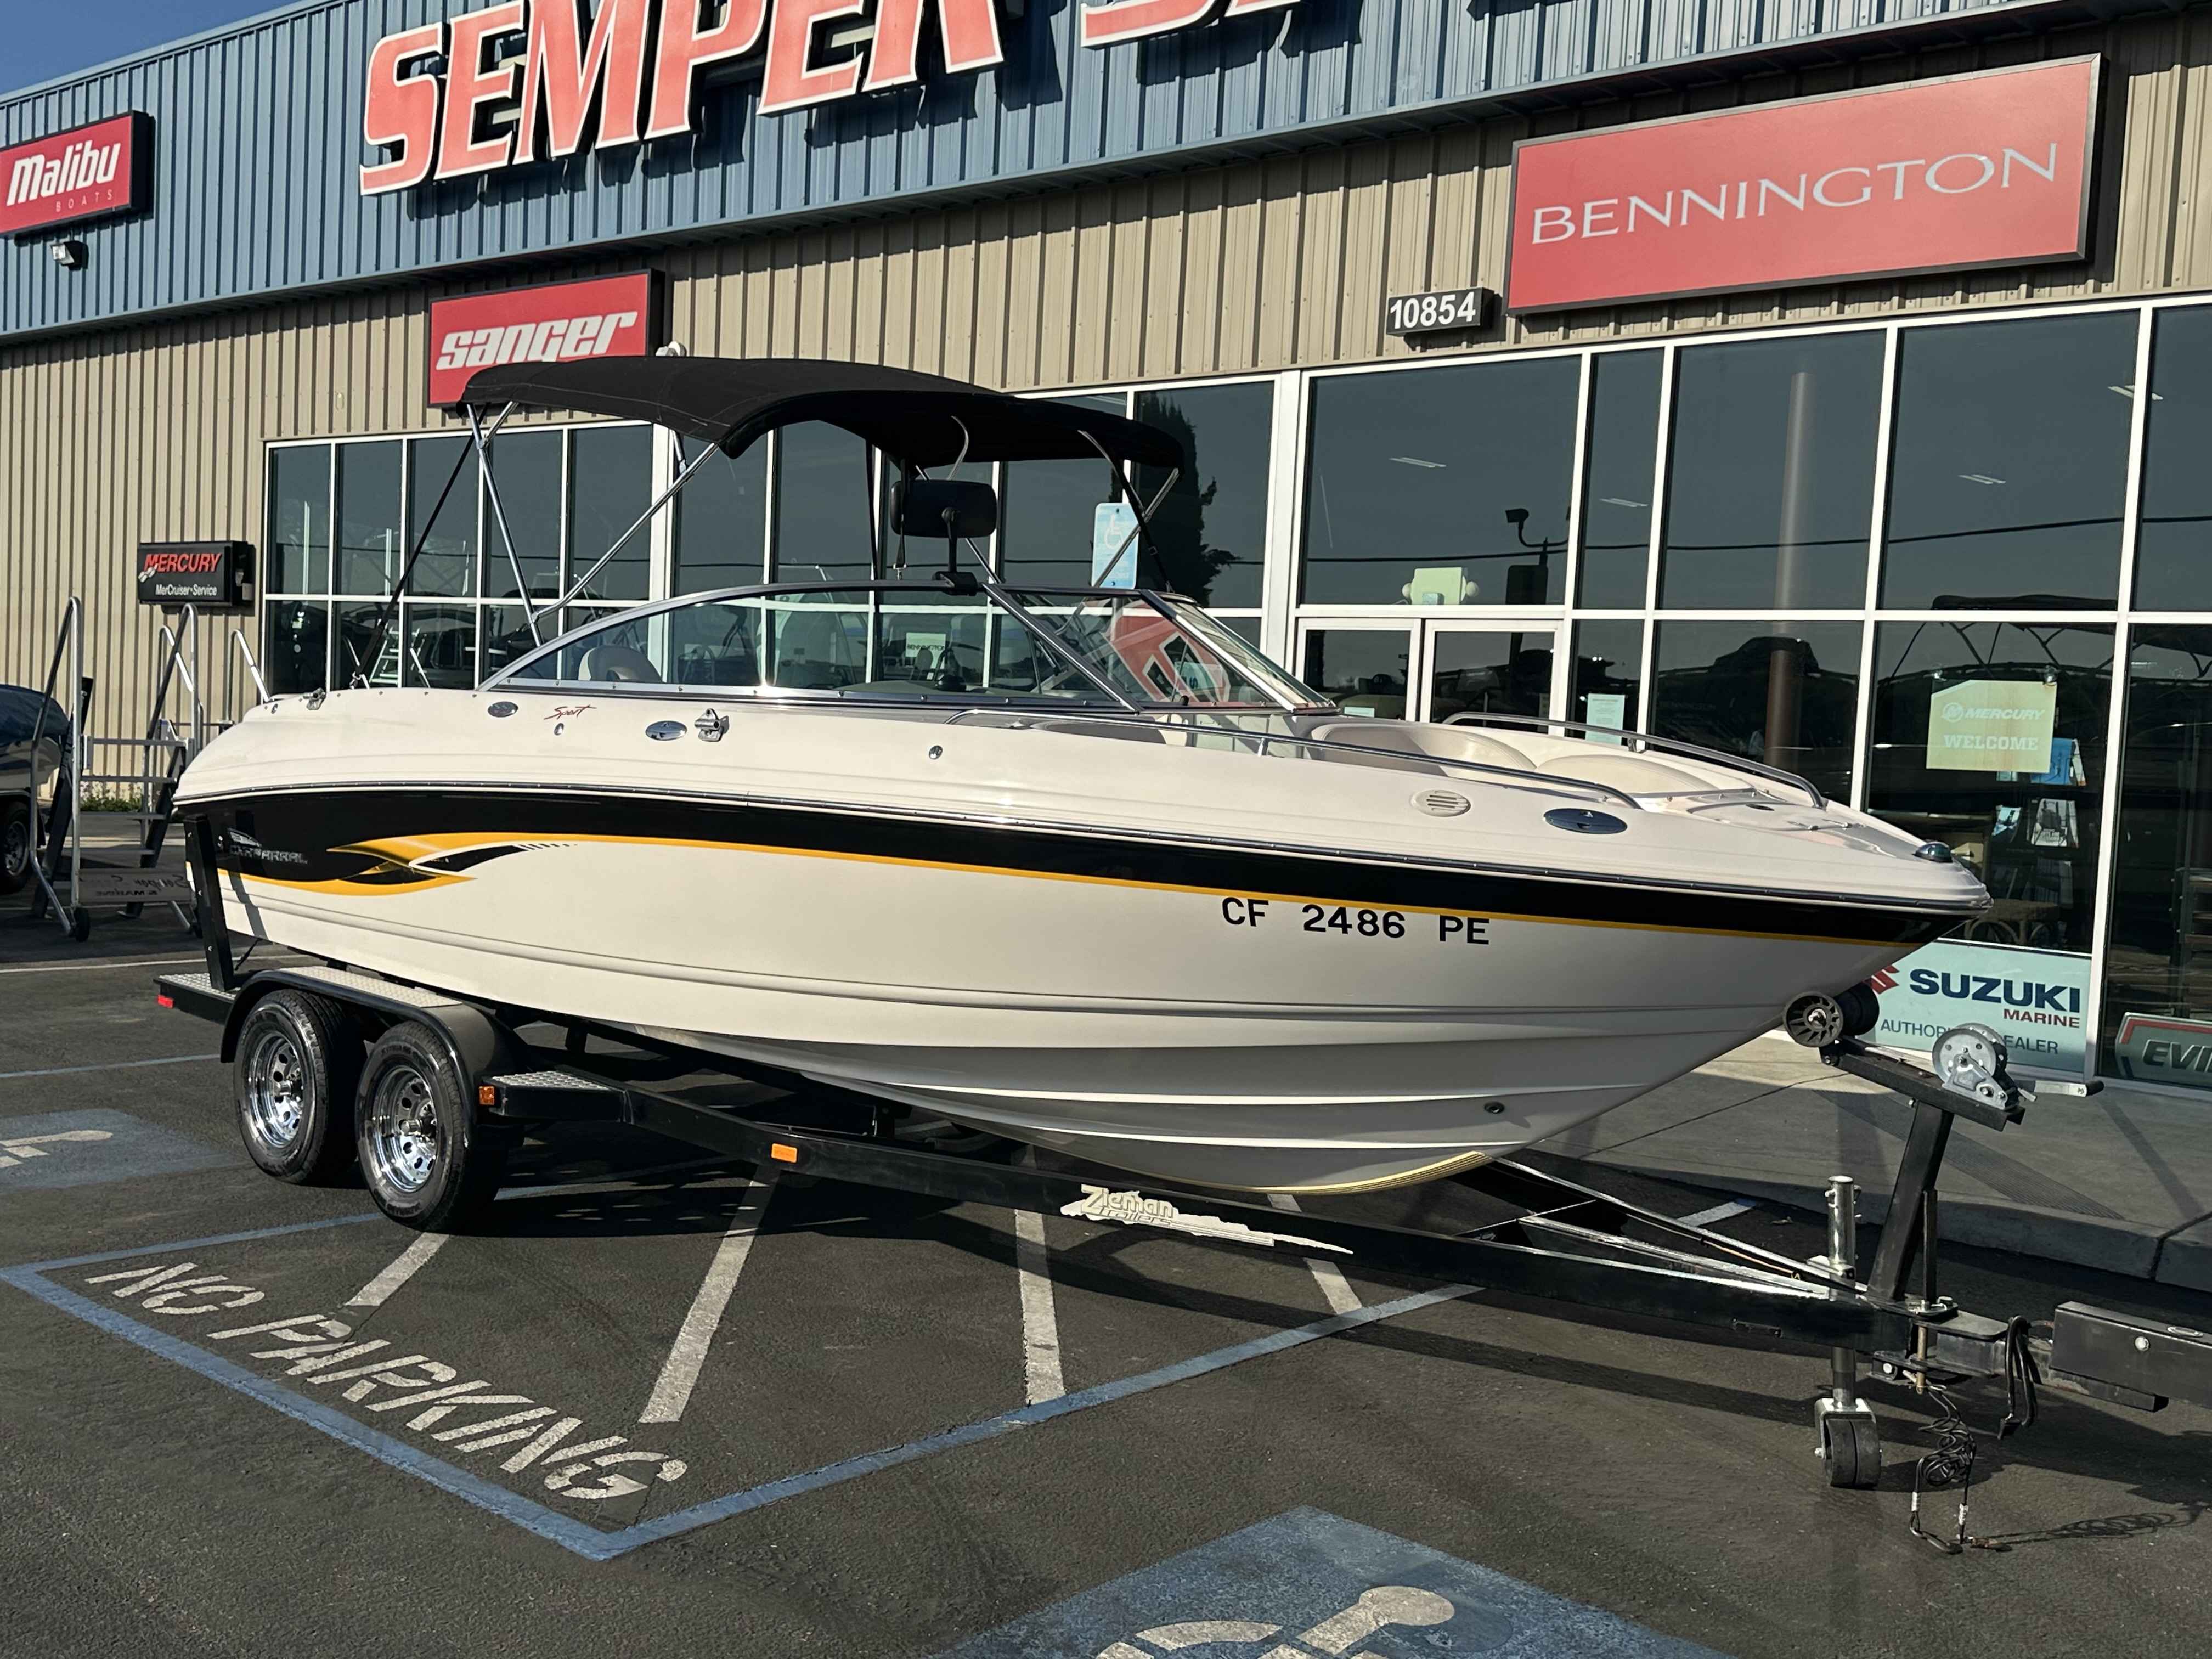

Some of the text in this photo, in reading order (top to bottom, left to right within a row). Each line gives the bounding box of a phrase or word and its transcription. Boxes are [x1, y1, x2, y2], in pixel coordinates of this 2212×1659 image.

[6, 139, 121, 207] Malibu
[55, 189, 112, 212] BOATS
[1531, 143, 2057, 244] BENNINGTON
[1390, 291, 1476, 329] 10854
[143, 552, 222, 573] MERCURY
[544, 704, 597, 720] Sport
[1964, 708, 2046, 720] MERCURY
[1943, 735, 2039, 751] WELCOME
[1221, 896, 1489, 945] CF 2486 PE
[1909, 969, 2080, 1013] SUZUKI
[2003, 1008, 2080, 1029] MARINE
[1880, 1019, 2059, 1054] AUTHOR EALER
[1081, 1184, 1173, 1218] Zieman
[83, 1262, 265, 1316] NO
[206, 1313, 687, 1500] PARKING
